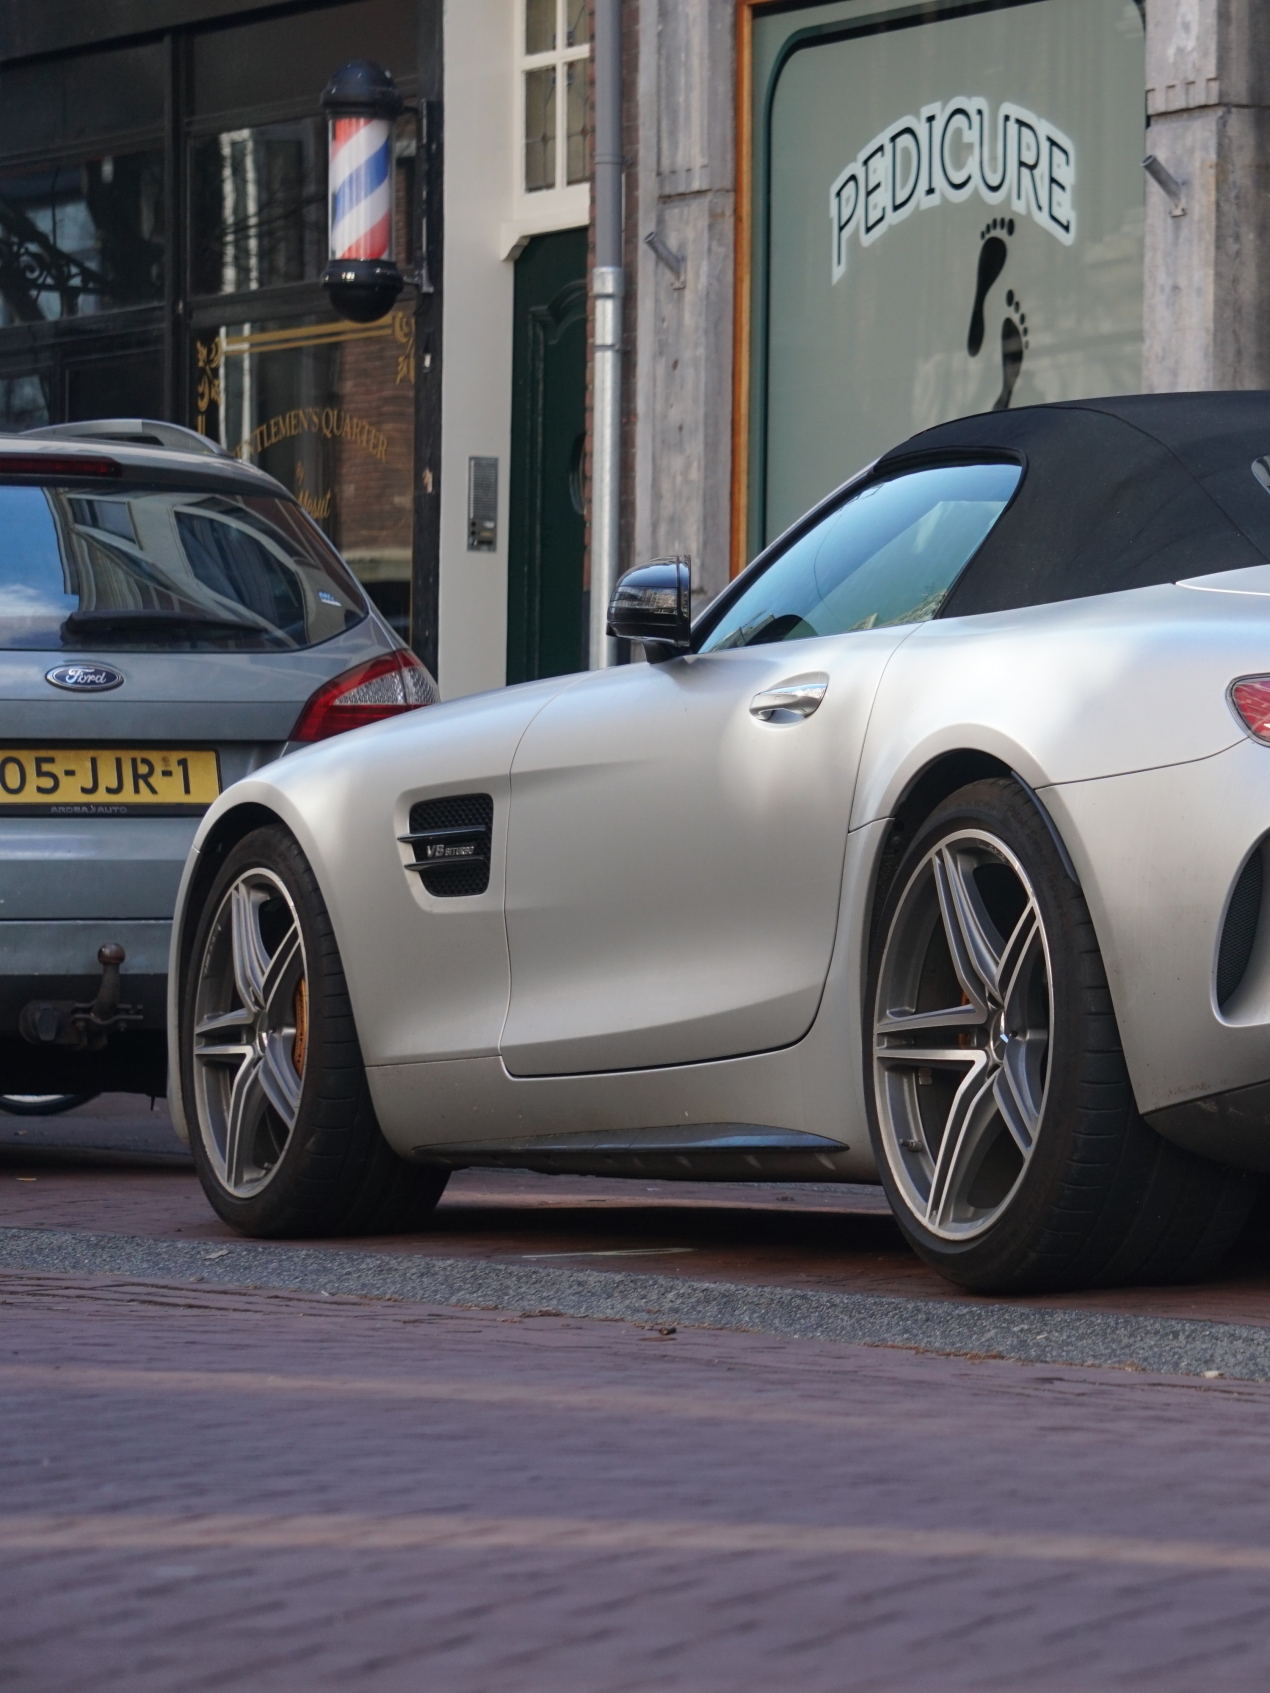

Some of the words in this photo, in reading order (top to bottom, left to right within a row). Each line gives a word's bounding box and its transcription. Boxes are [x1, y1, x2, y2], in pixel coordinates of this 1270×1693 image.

[830, 97, 1074, 286] PEDICURE
[322, 408, 388, 463] QUARTER
[65, 668, 107, 684] Ford
[0, 756, 191, 795] 05-JJR-1
[96, 806, 127, 814] AUTO
[427, 845, 444, 857] V8
